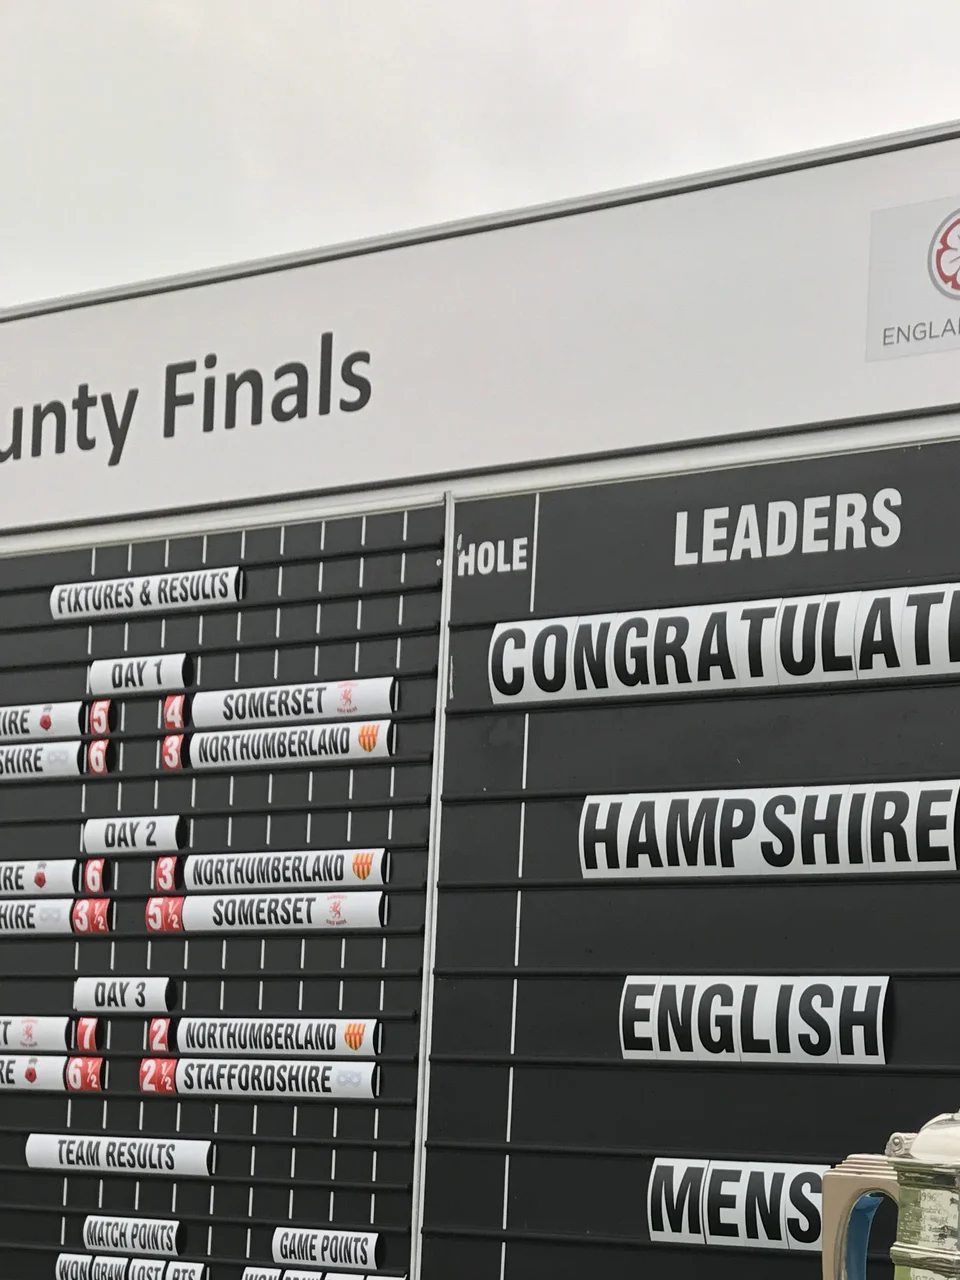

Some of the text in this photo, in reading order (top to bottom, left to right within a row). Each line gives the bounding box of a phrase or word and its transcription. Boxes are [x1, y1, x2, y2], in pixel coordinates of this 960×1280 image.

[163, 331, 372, 439] Finals
[457, 536, 528, 577] HOLE
[675, 488, 902, 566] LEADERS
[58, 571, 229, 614] FIXTURES & RESULTS
[112, 659, 162, 688] DAY 1
[0, 687, 327, 736] IRE 5 4 SOMERSET
[89, 741, 105, 773] 6
[164, 737, 180, 768] 3
[198, 727, 350, 763] NORTHUMBERLAND
[105, 820, 157, 848] DAY 2
[583, 789, 954, 869] HAMPSHIRE
[86, 858, 101, 889] 6
[158, 856, 173, 888] 3
[193, 854, 345, 886] NORTHUMBERLAND
[212, 897, 316, 926] SOMERSET
[94, 982, 146, 1008] DAY 3
[82, 1020, 96, 1049] 7
[151, 1019, 167, 1051] 2
[185, 1022, 337, 1051] NORTHUMBERLAND
[622, 983, 881, 1056] ENGLISH
[184, 1064, 332, 1093] STAFFORDSHIRE
[58, 1139, 176, 1170] TEAM RESULTS
[651, 1165, 822, 1244] MENS
[87, 1219, 369, 1266] MATCH POINTS GAME POINTS
